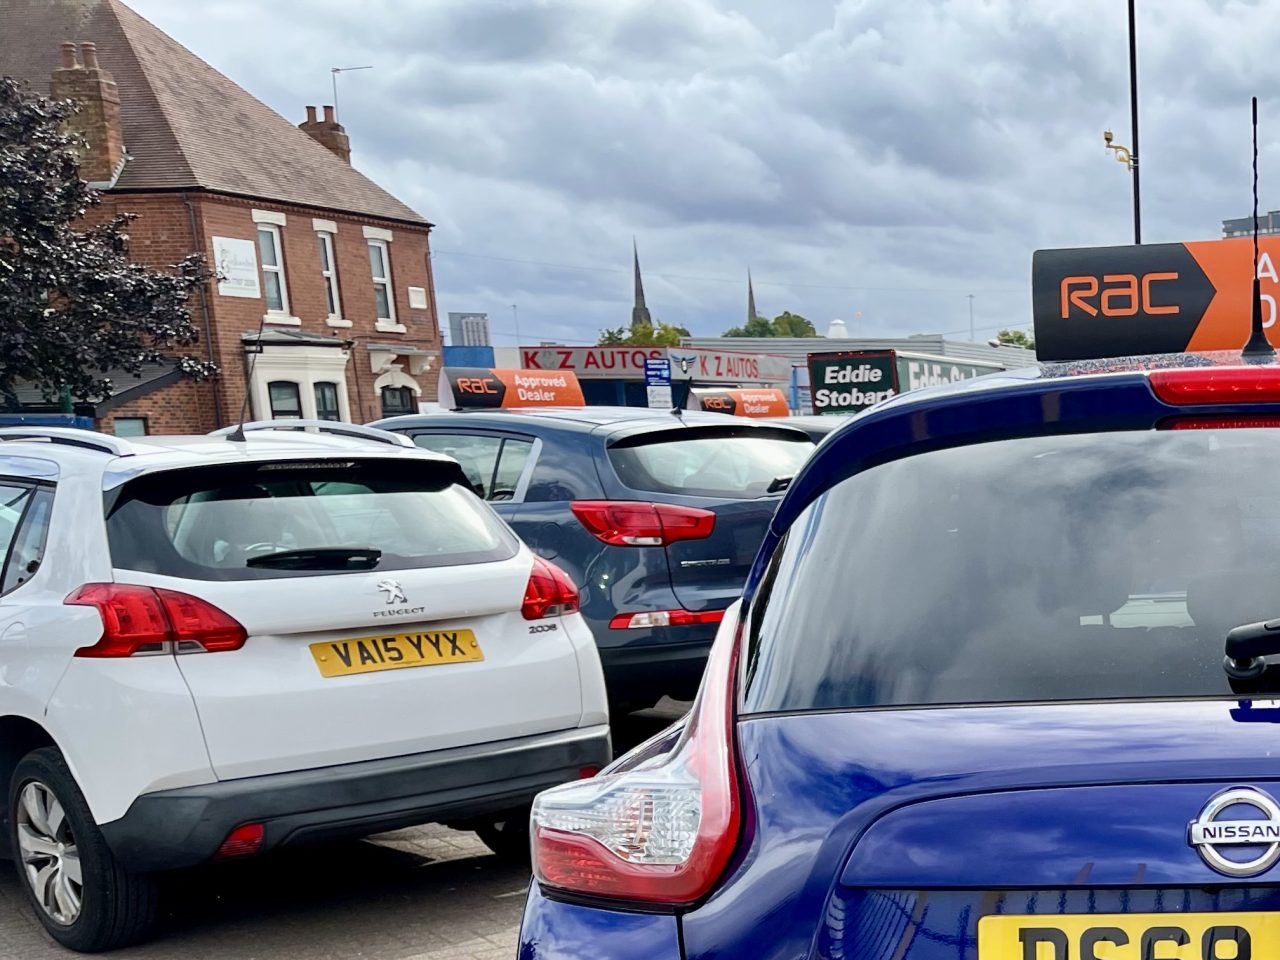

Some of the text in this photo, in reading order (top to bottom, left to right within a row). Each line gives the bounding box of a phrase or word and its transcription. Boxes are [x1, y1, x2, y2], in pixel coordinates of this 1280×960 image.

[727, 356, 759, 378] AUTOS
[824, 364, 883, 384] Eddie
[514, 374, 568, 388] Approved
[517, 388, 556, 402] Dealer
[814, 388, 895, 407] Stobart
[372, 606, 426, 618] PEUGEOT
[528, 623, 558, 634] 2008
[331, 632, 466, 668] VA15 YYX
[1202, 825, 1280, 839] NISSAN
